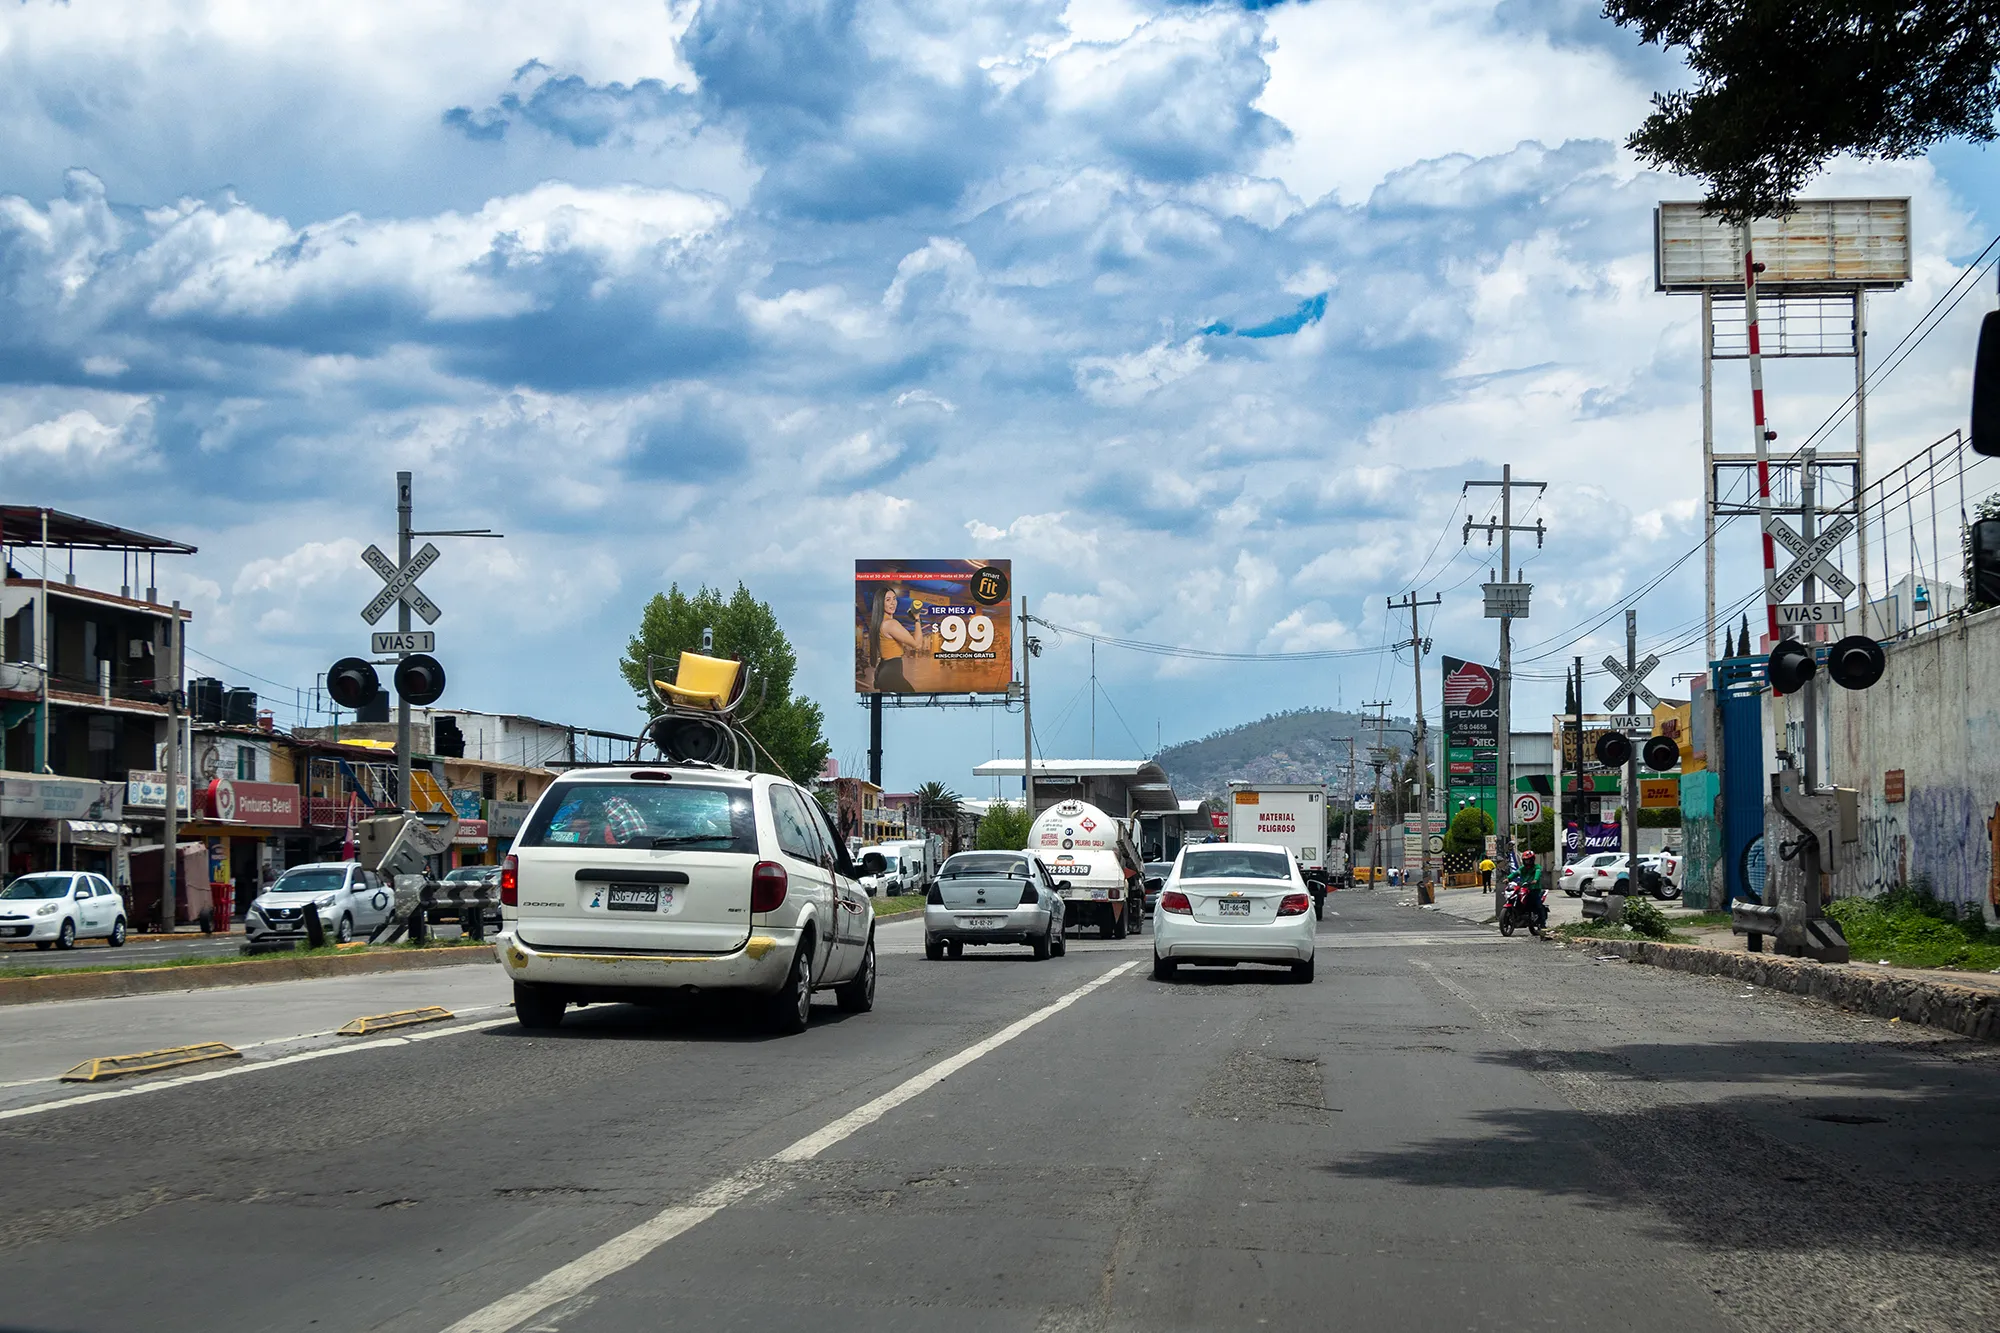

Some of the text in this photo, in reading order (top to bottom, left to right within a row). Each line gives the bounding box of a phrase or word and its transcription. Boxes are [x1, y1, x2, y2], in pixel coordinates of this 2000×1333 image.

[1775, 524, 1848, 596] FERROCARRIL
[1776, 528, 1846, 590] CRUCE DE
[368, 552, 430, 613] CRUCE DE
[982, 572, 1000, 580] smart
[367, 552, 434, 620] FERROCARRIL
[980, 578, 998, 595] fit
[1784, 606, 1837, 621] VIAS 1
[379, 635, 428, 649] VIAS 1
[1606, 660, 1653, 702] CRUCE DE
[1608, 661, 1656, 707] FERROCARRIL
[1450, 709, 1498, 718] PEMEX
[1615, 717, 1650, 727] VIAS 1
[1583, 730, 1604, 744] REN
[1648, 789, 1672, 798] DHL
[240, 797, 270, 812] Pinturas
[272, 798, 292, 813] Berel
[1522, 800, 1534, 812] 60
[1584, 836, 1618, 847] TALIKA
[610, 890, 657, 903] NSG-77-22
